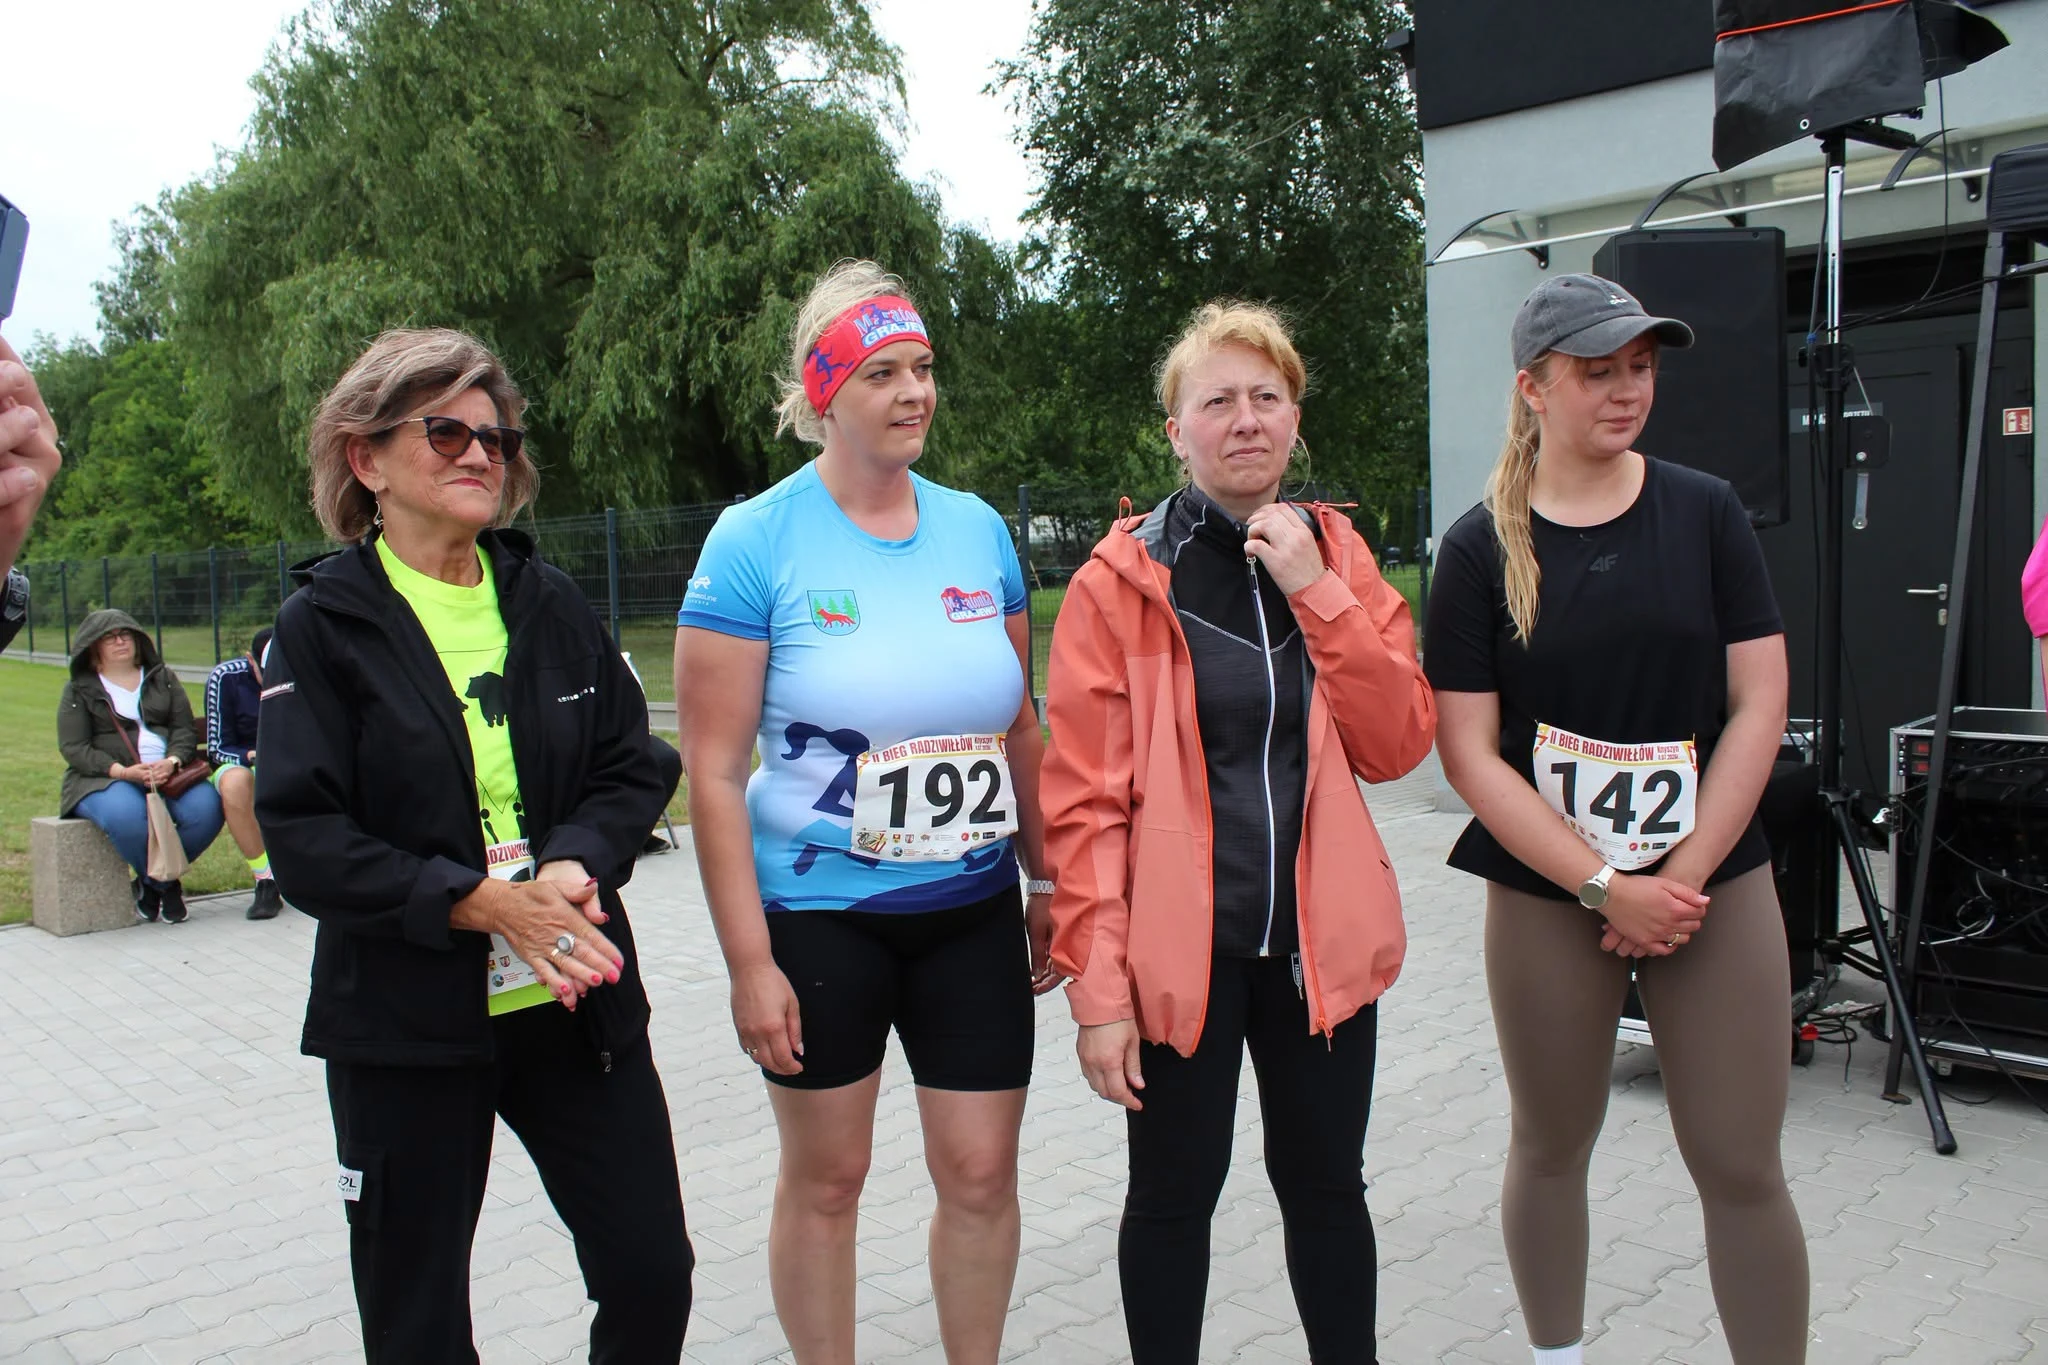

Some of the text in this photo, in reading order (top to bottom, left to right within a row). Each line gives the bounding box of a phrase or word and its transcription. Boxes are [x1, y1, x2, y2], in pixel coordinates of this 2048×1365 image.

[1590, 553, 1619, 573] 4F
[872, 735, 973, 763] II BIEG RADZIWIŁŁÓW
[1550, 730, 1655, 762] II BIEG RADZIWIŁŁÓW
[878, 759, 1006, 829] 192
[1551, 761, 1682, 835] 142
